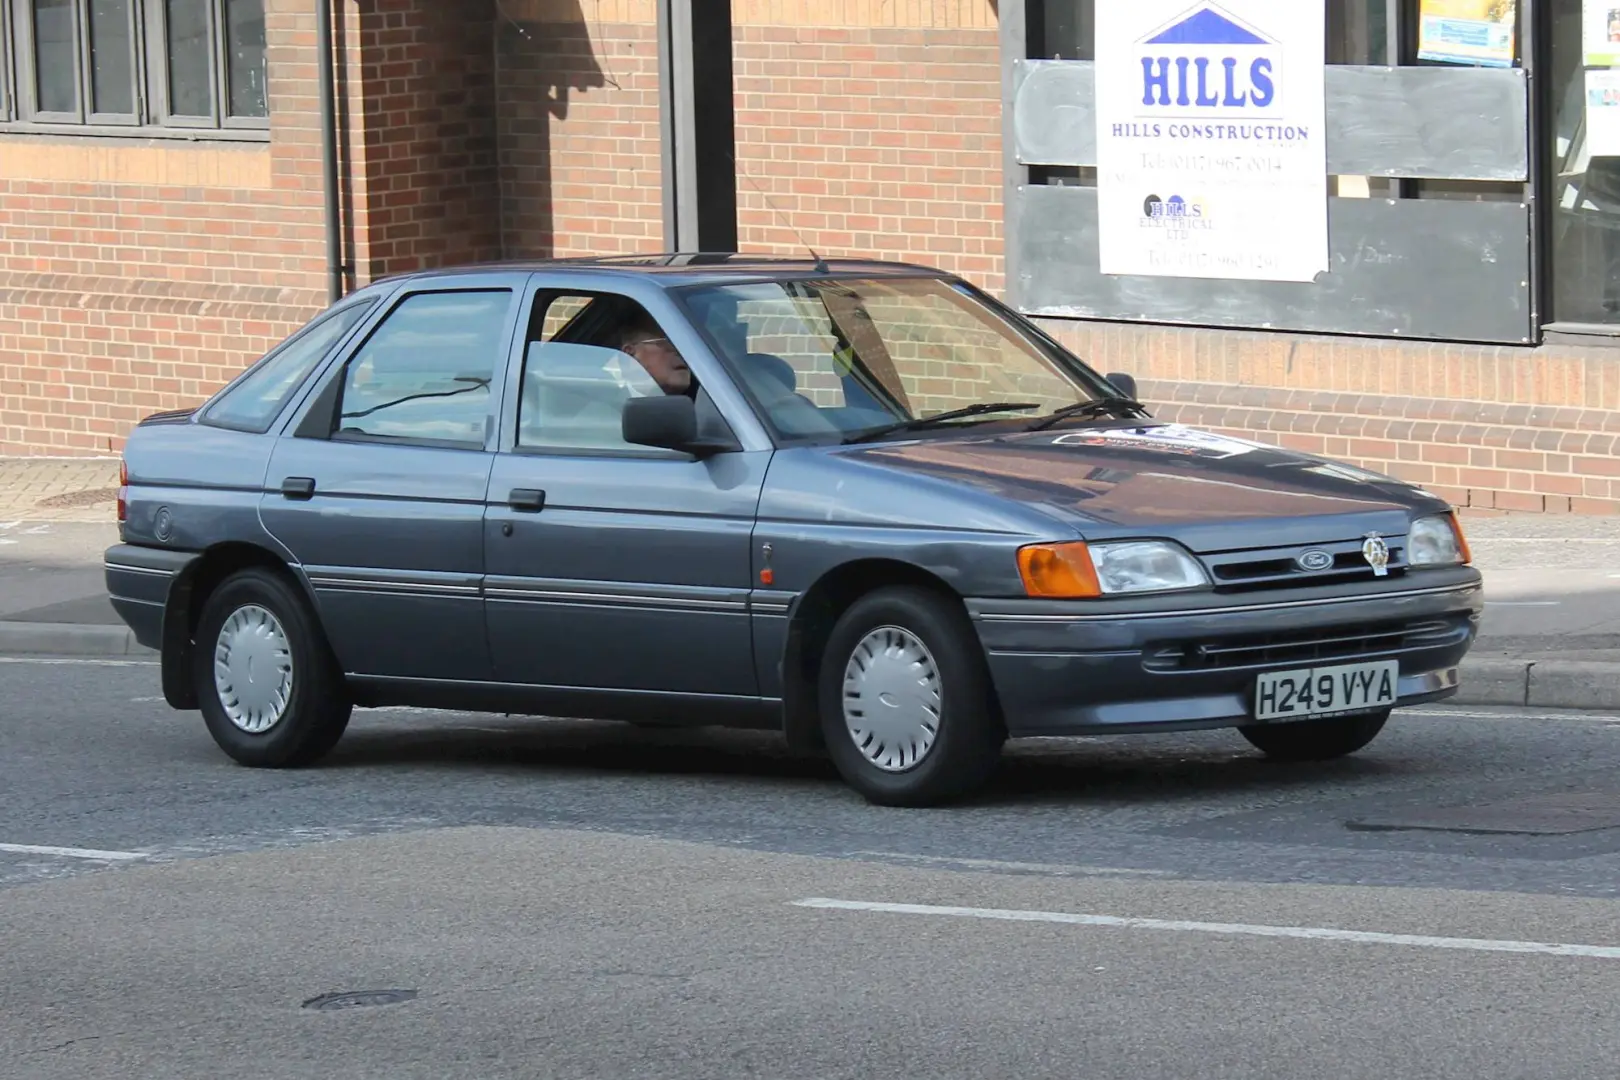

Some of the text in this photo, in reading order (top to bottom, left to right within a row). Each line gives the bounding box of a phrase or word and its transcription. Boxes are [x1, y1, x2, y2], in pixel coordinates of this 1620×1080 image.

[1141, 57, 1274, 107] HILLS
[1112, 123, 1308, 140] HILLS CONSTRUCTION
[1151, 202, 1202, 217] HILLS
[1139, 217, 1214, 230] ELECTRICAL
[1166, 229, 1189, 240] LTD
[1308, 554, 1325, 566] Ford
[1259, 668, 1393, 715] H249 VYA
